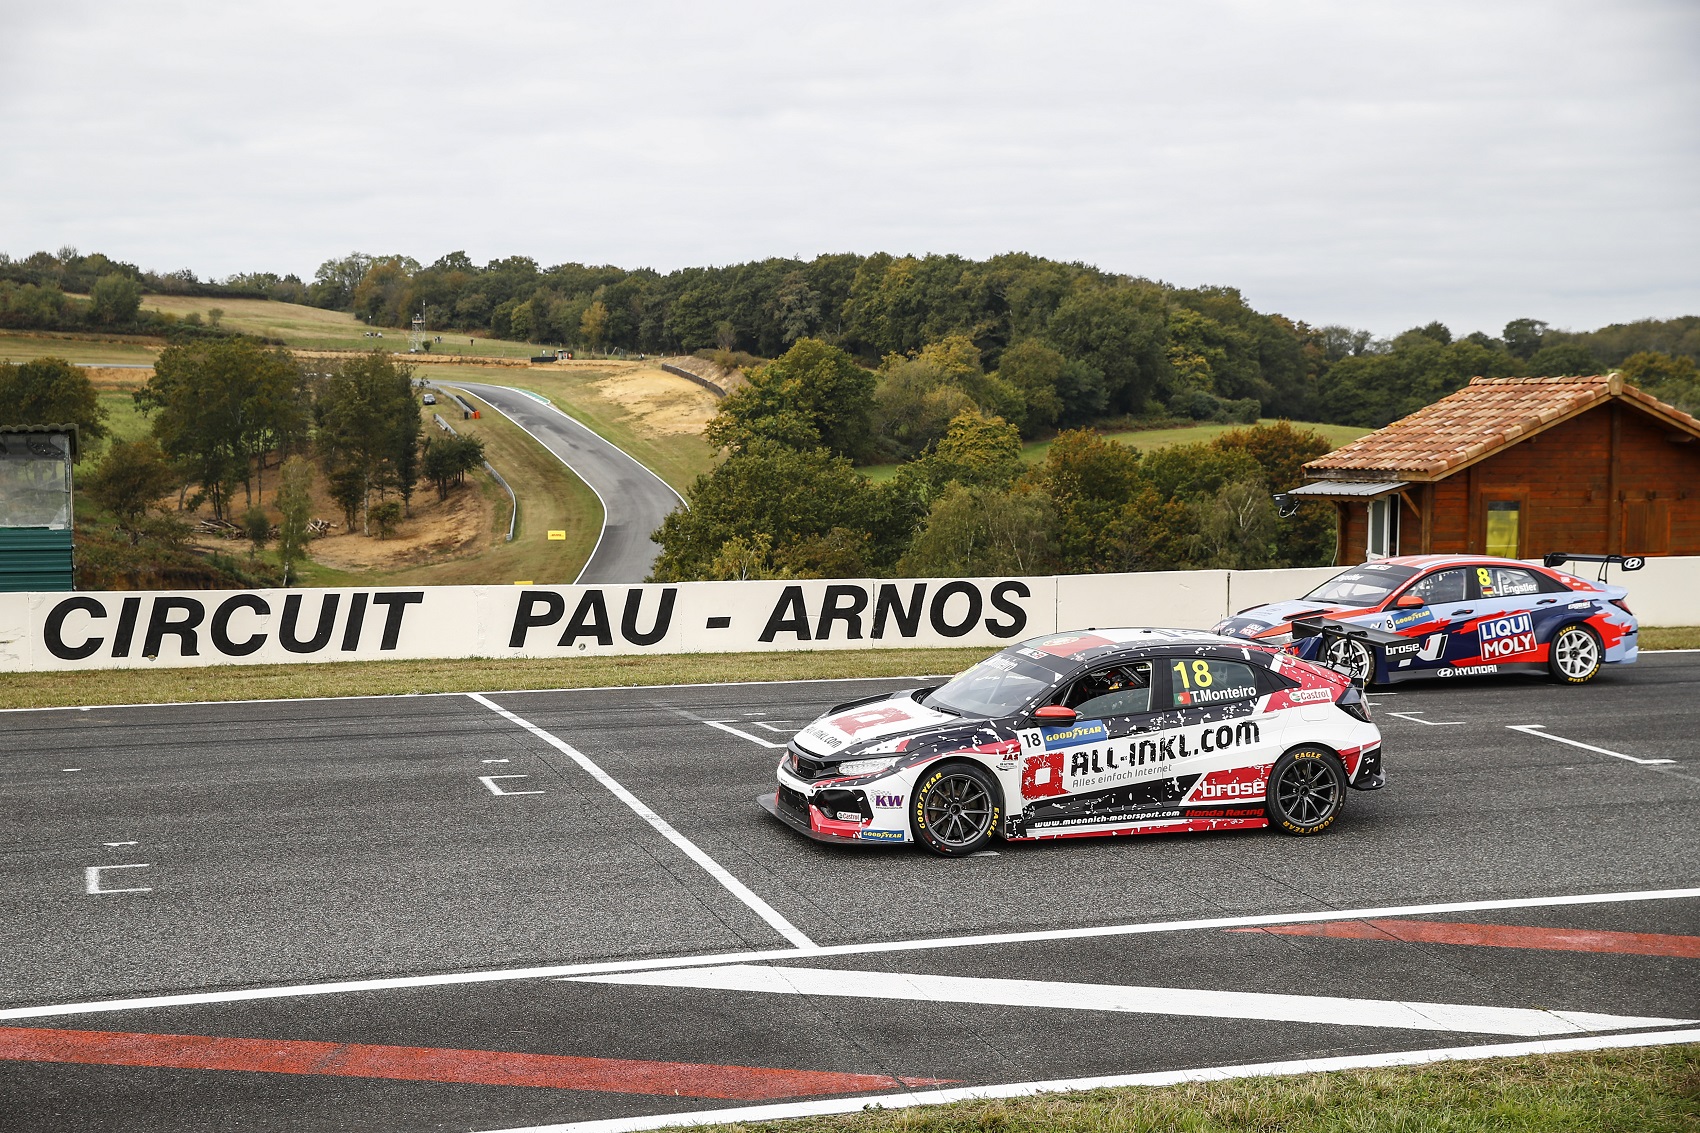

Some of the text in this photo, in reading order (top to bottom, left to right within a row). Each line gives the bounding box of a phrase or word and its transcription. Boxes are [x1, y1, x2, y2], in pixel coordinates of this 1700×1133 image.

[1476, 567, 1491, 586] 8
[1503, 582, 1537, 595] Engstler
[43, 579, 1031, 660] CIRCUIT PAU - ARNOS
[1386, 619, 1394, 629] 8
[1395, 610, 1430, 625] GOODYEAR
[1482, 613, 1531, 640] LIQUI
[1385, 643, 1420, 656] brose
[1484, 633, 1533, 660] MOLY
[1173, 659, 1213, 689] 18
[1454, 664, 1498, 676] HYUNDAI
[1189, 685, 1257, 704] T.Monteiro
[1300, 689, 1330, 700] Castrol
[1022, 732, 1042, 749] 18
[1045, 725, 1102, 742] GOODYEAR
[1294, 751, 1322, 760] EAGLE
[1072, 763, 1172, 788] Alles einfach Internet
[1202, 780, 1265, 798] brose
[875, 794, 905, 807] KW
[842, 812, 860, 820] Castrol
[1034, 810, 1180, 828] www.muennich-motorsport.com
[1185, 807, 1265, 817] Honda Racing
[986, 806, 1000, 838] EAGLE
[863, 830, 903, 839] GOODYEAR
